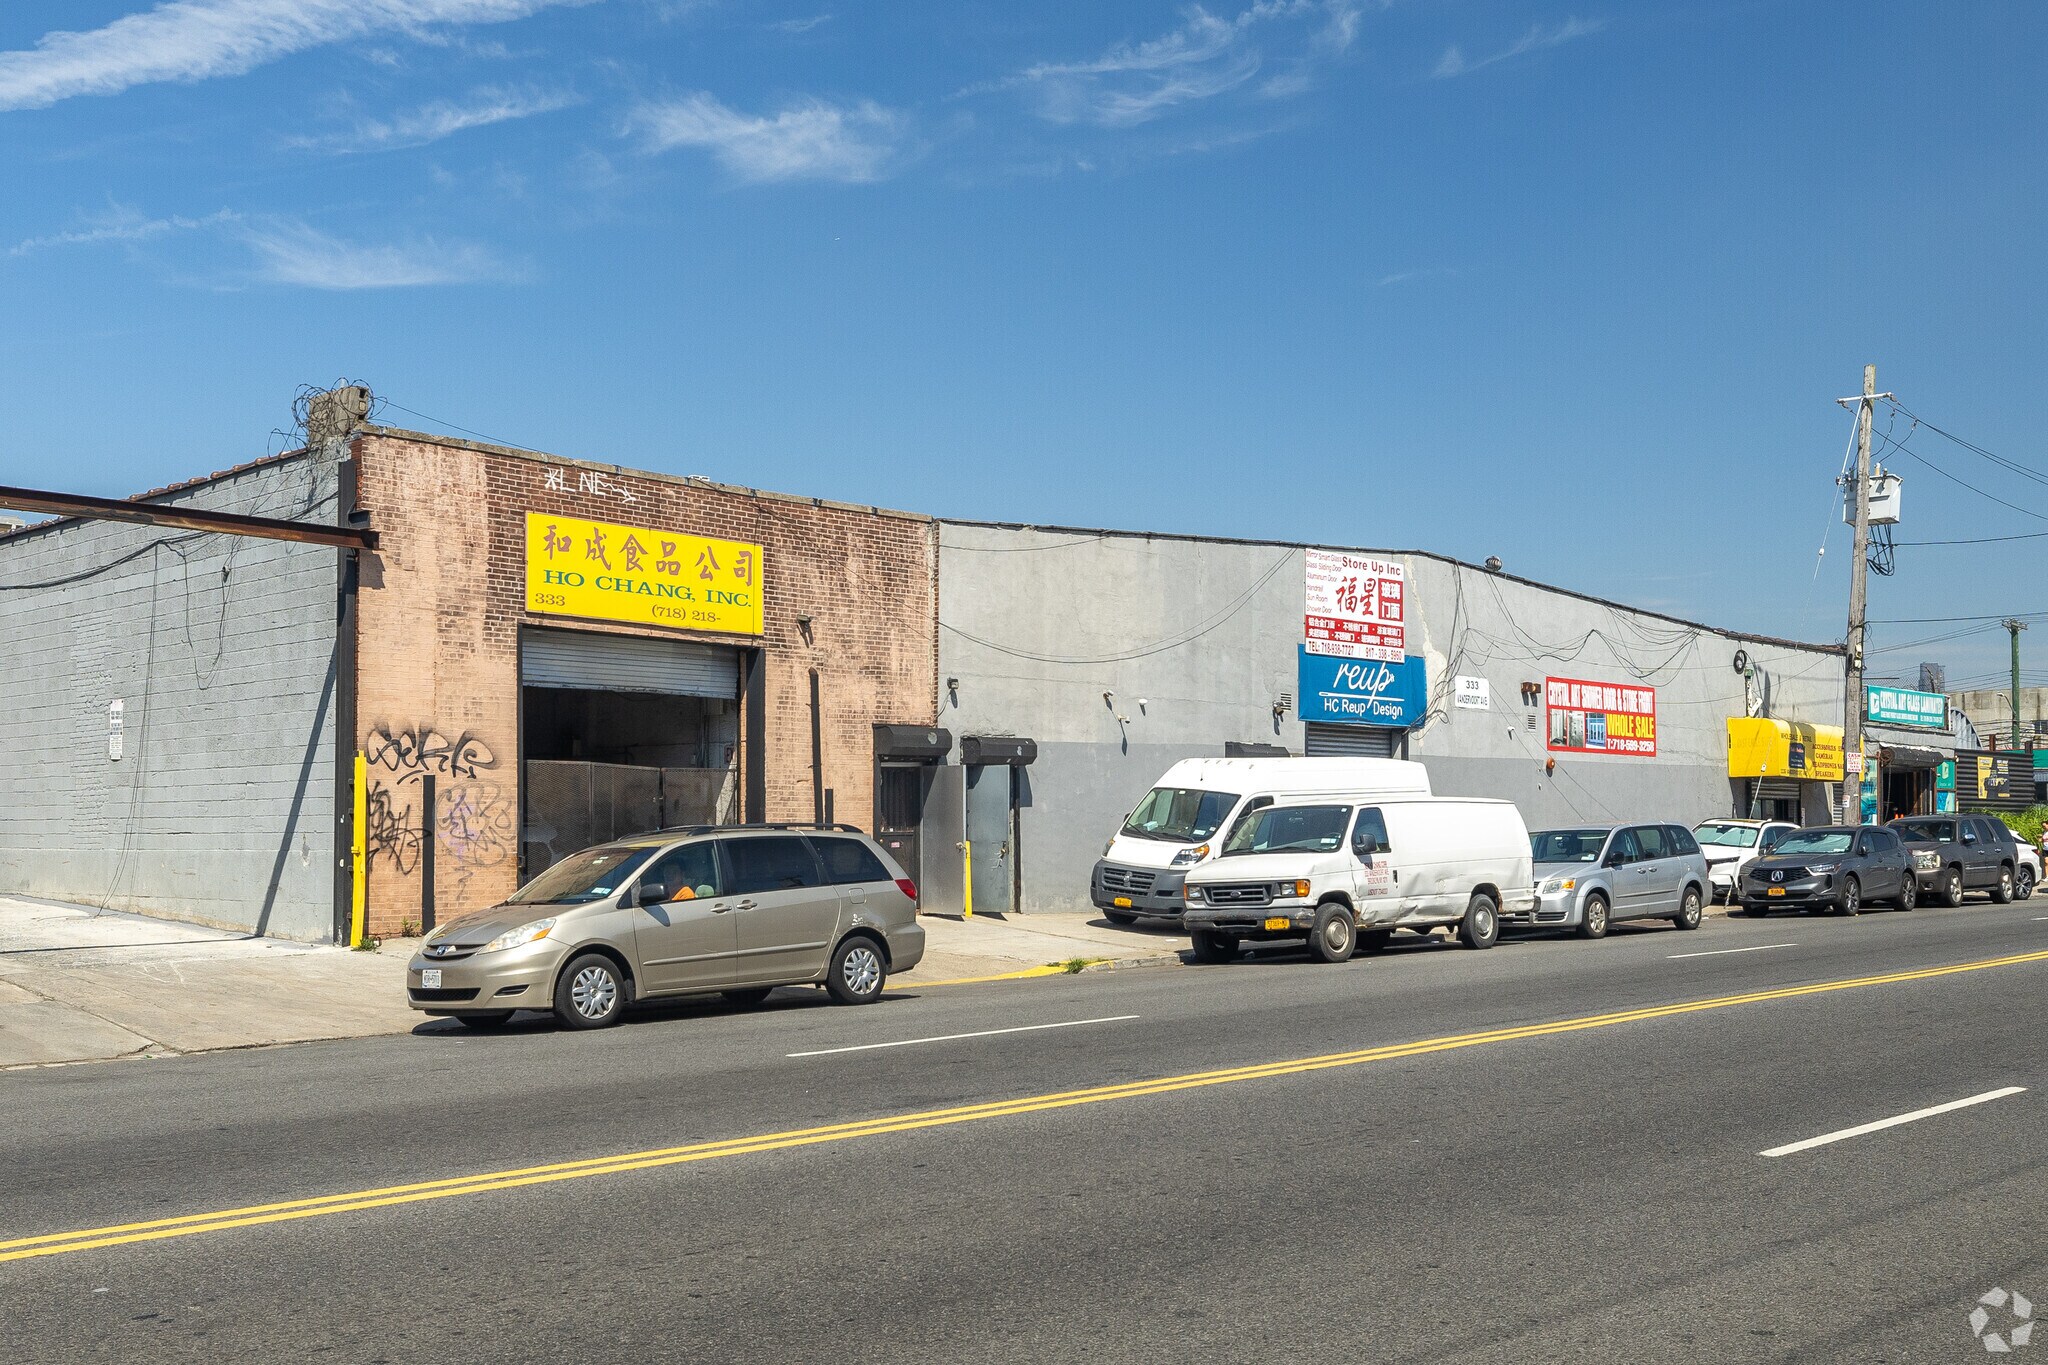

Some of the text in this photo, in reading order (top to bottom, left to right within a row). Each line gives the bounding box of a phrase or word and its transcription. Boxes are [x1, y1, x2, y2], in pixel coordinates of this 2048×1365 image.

[543, 524, 753, 587] 和成食品公司
[1332, 564, 1342, 573] Door
[1342, 556, 1401, 576] Store Up Inc
[1328, 574, 1338, 583] Door
[543, 569, 752, 608] HO CHANG, INC.
[1307, 593, 1316, 602] Sun
[1335, 576, 1377, 616] 福星
[535, 592, 566, 607] 333
[651, 604, 687, 621] (718)
[1308, 641, 1320, 652] TEL:
[1465, 680, 1479, 690] 333
[1548, 681, 1570, 707] CRYSTAL
[1617, 689, 1623, 712] &
[1622, 689, 1639, 713] STORE
[1324, 697, 1403, 720] HC Reup Design
[1606, 713, 1655, 739] WHOLE SALE
